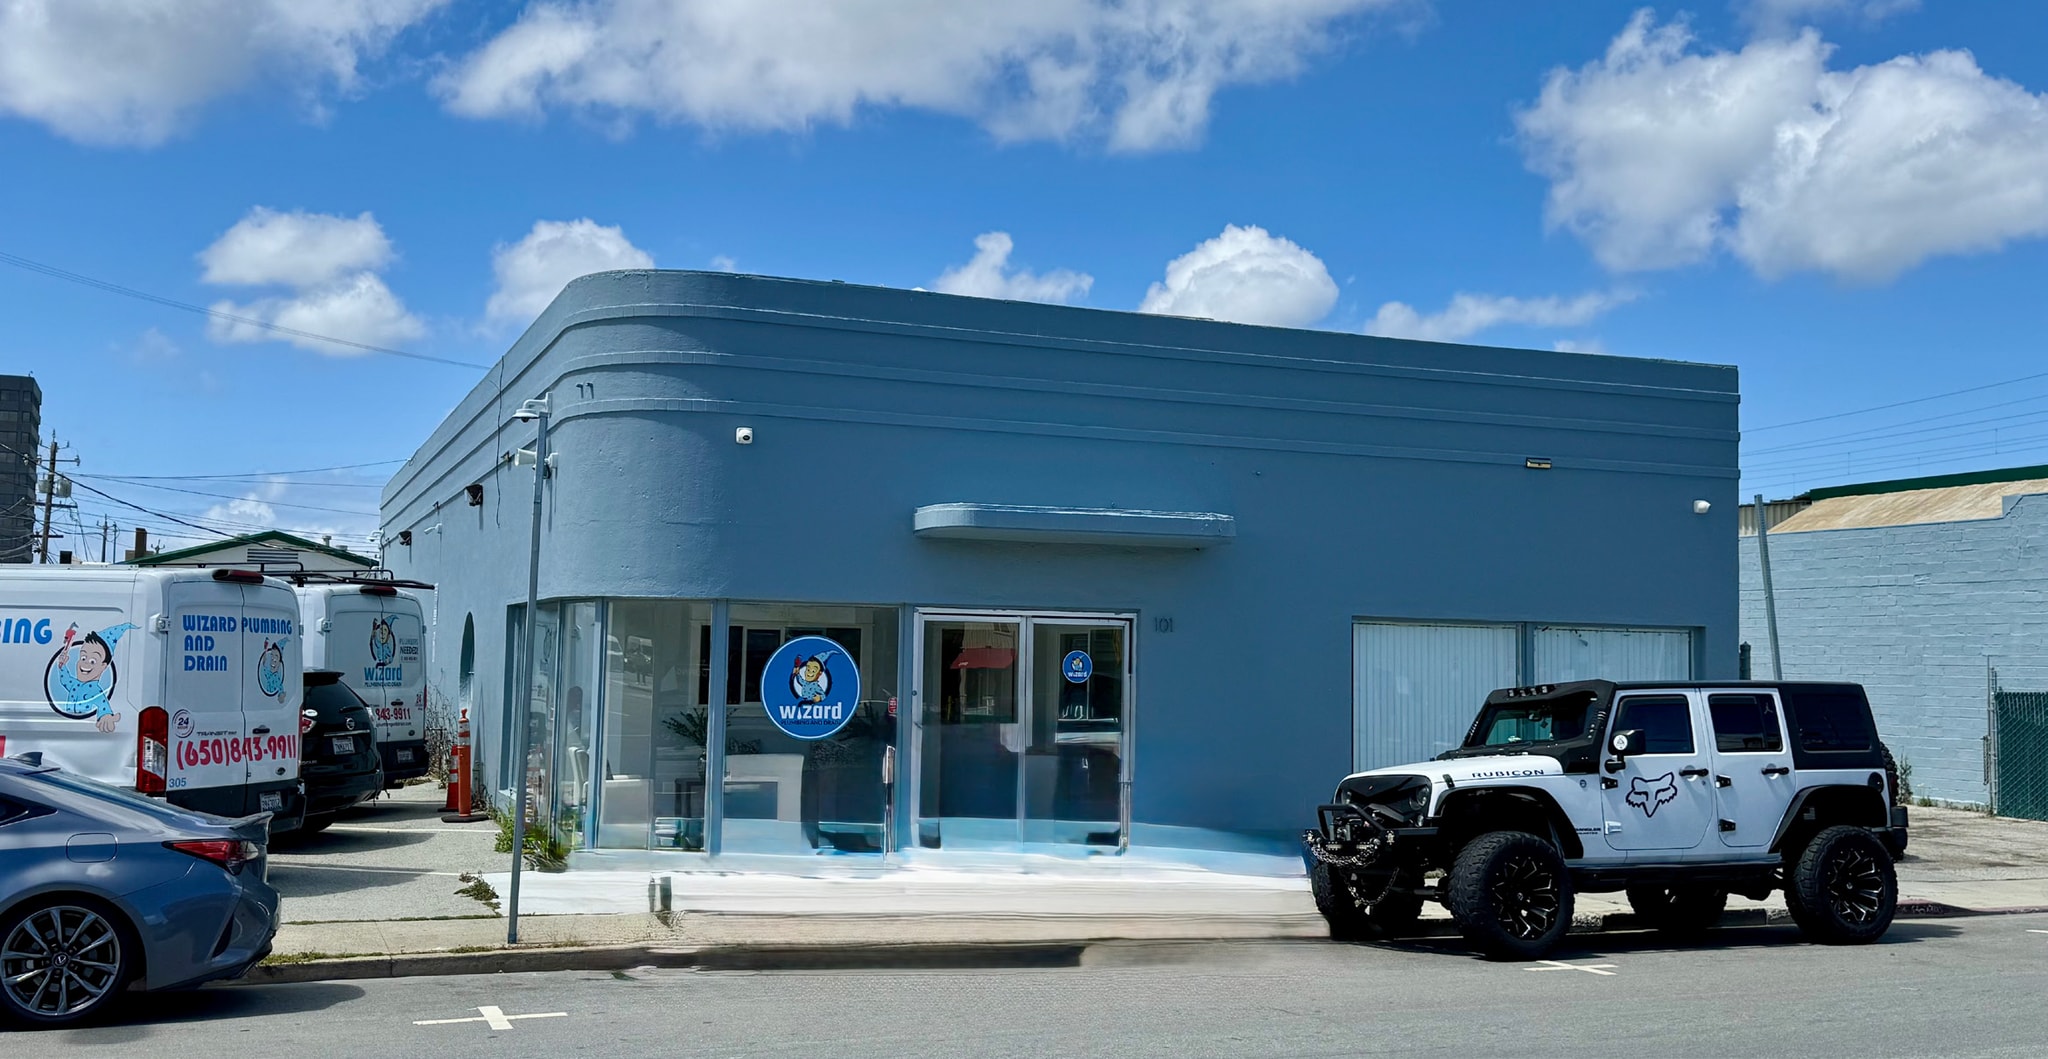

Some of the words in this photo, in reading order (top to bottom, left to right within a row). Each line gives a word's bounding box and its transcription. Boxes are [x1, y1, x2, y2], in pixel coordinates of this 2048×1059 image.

[0, 618, 53, 645] ING
[182, 615, 237, 632] WIZARD
[241, 617, 293, 635] PLUMBING
[1154, 616, 1173, 634] 101
[184, 634, 215, 651] AND
[184, 655, 228, 672] DRAIN
[364, 663, 403, 681] wizard
[779, 702, 842, 720] wizard
[177, 717, 189, 726] 24
[168, 777, 187, 788] 305
[1471, 769, 1545, 779] RUBICON
